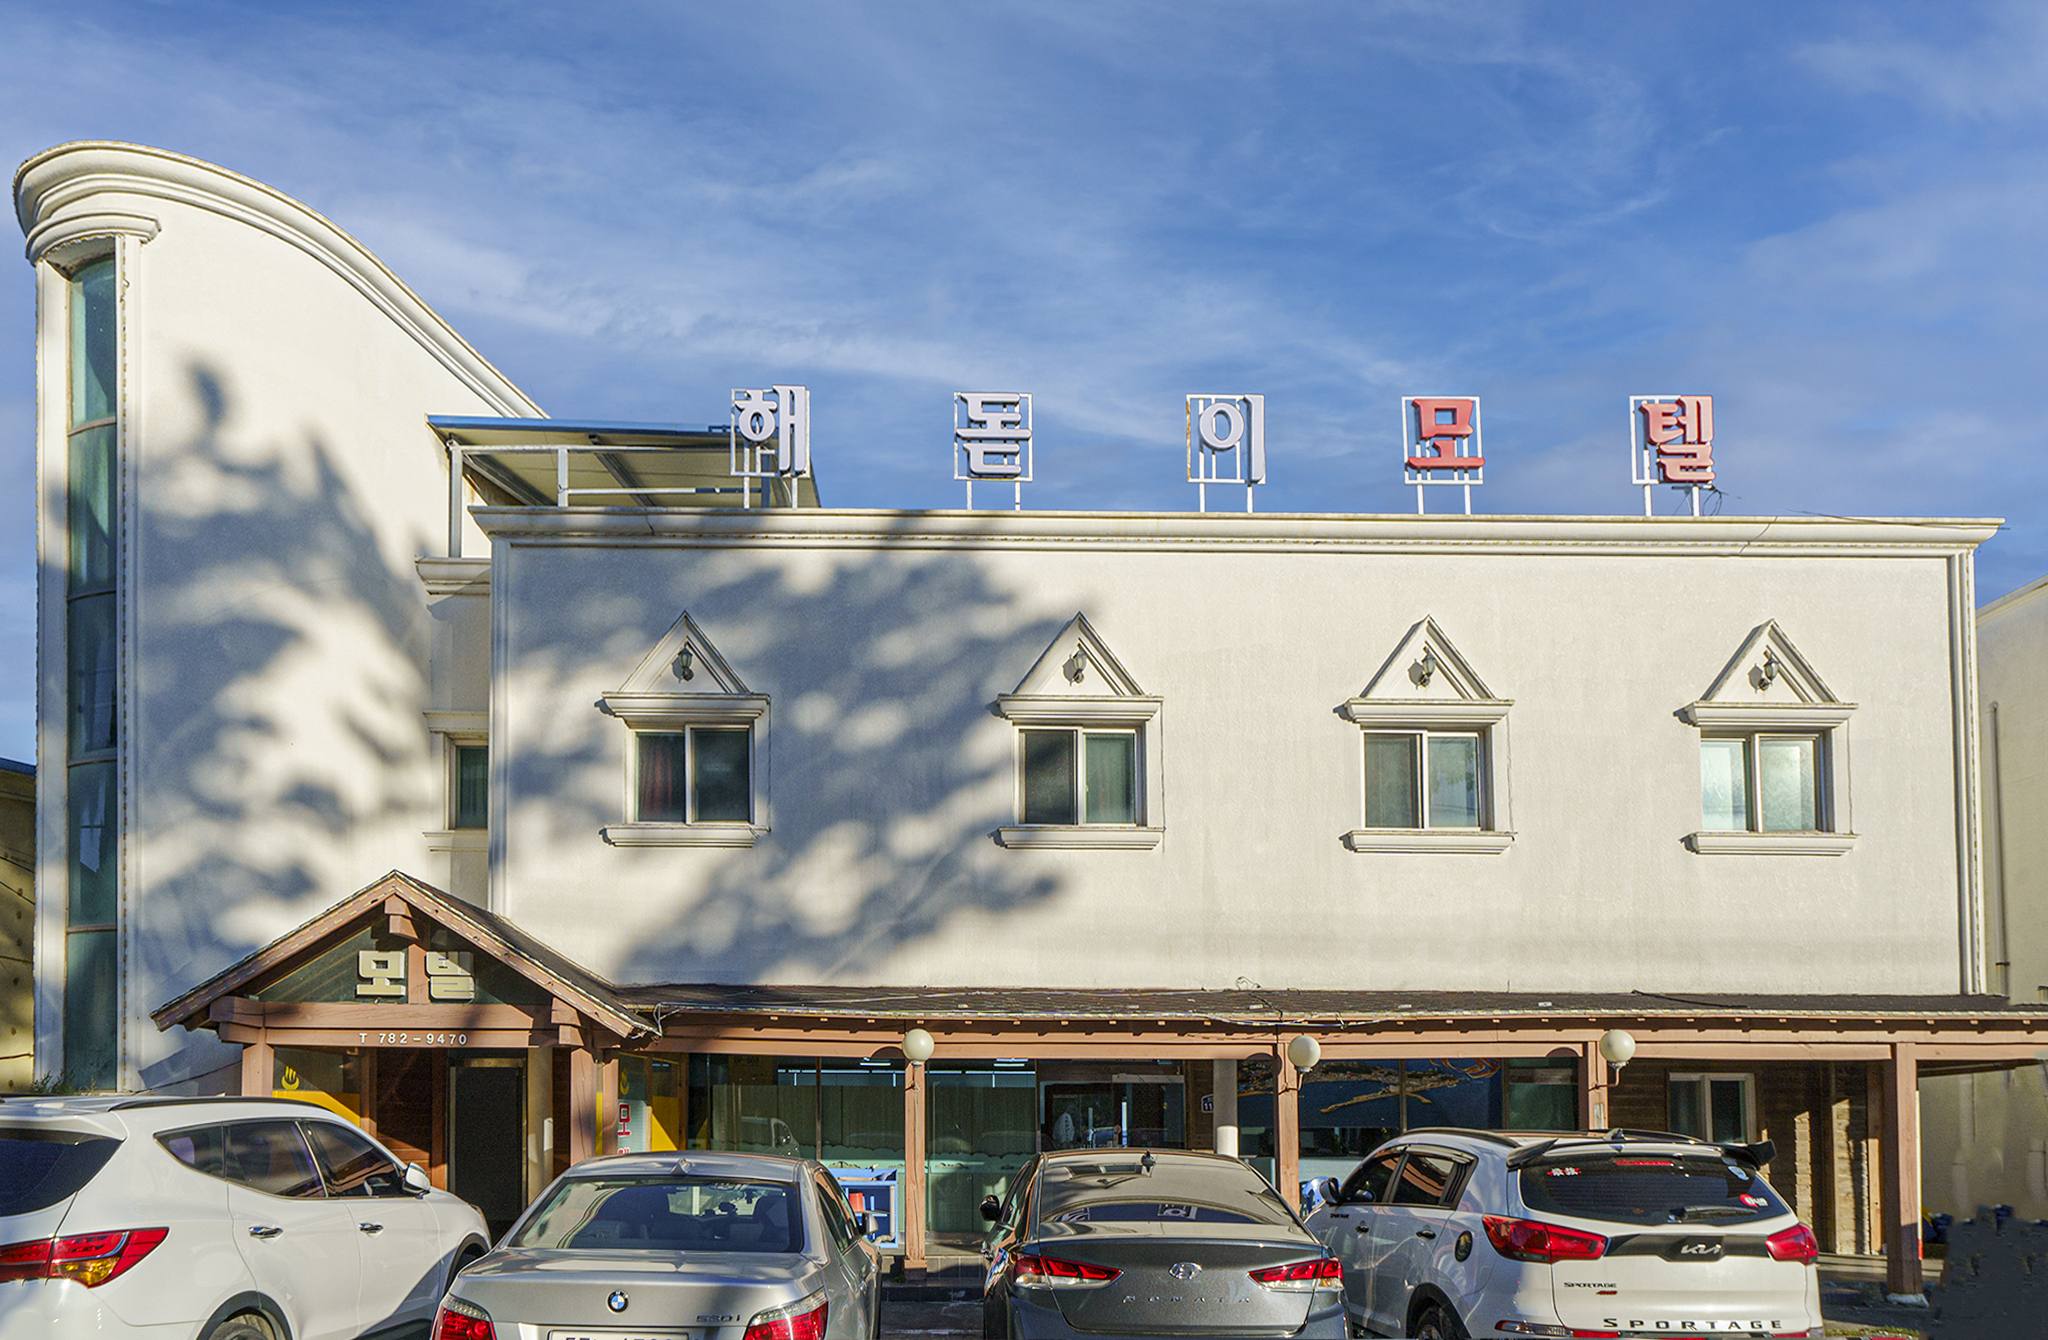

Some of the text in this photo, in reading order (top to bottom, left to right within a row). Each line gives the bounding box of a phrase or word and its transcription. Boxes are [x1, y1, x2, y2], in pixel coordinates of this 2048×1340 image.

[359, 1033, 467, 1046] T 782-9470
[1603, 1318, 1782, 1330] SPORTAGE
